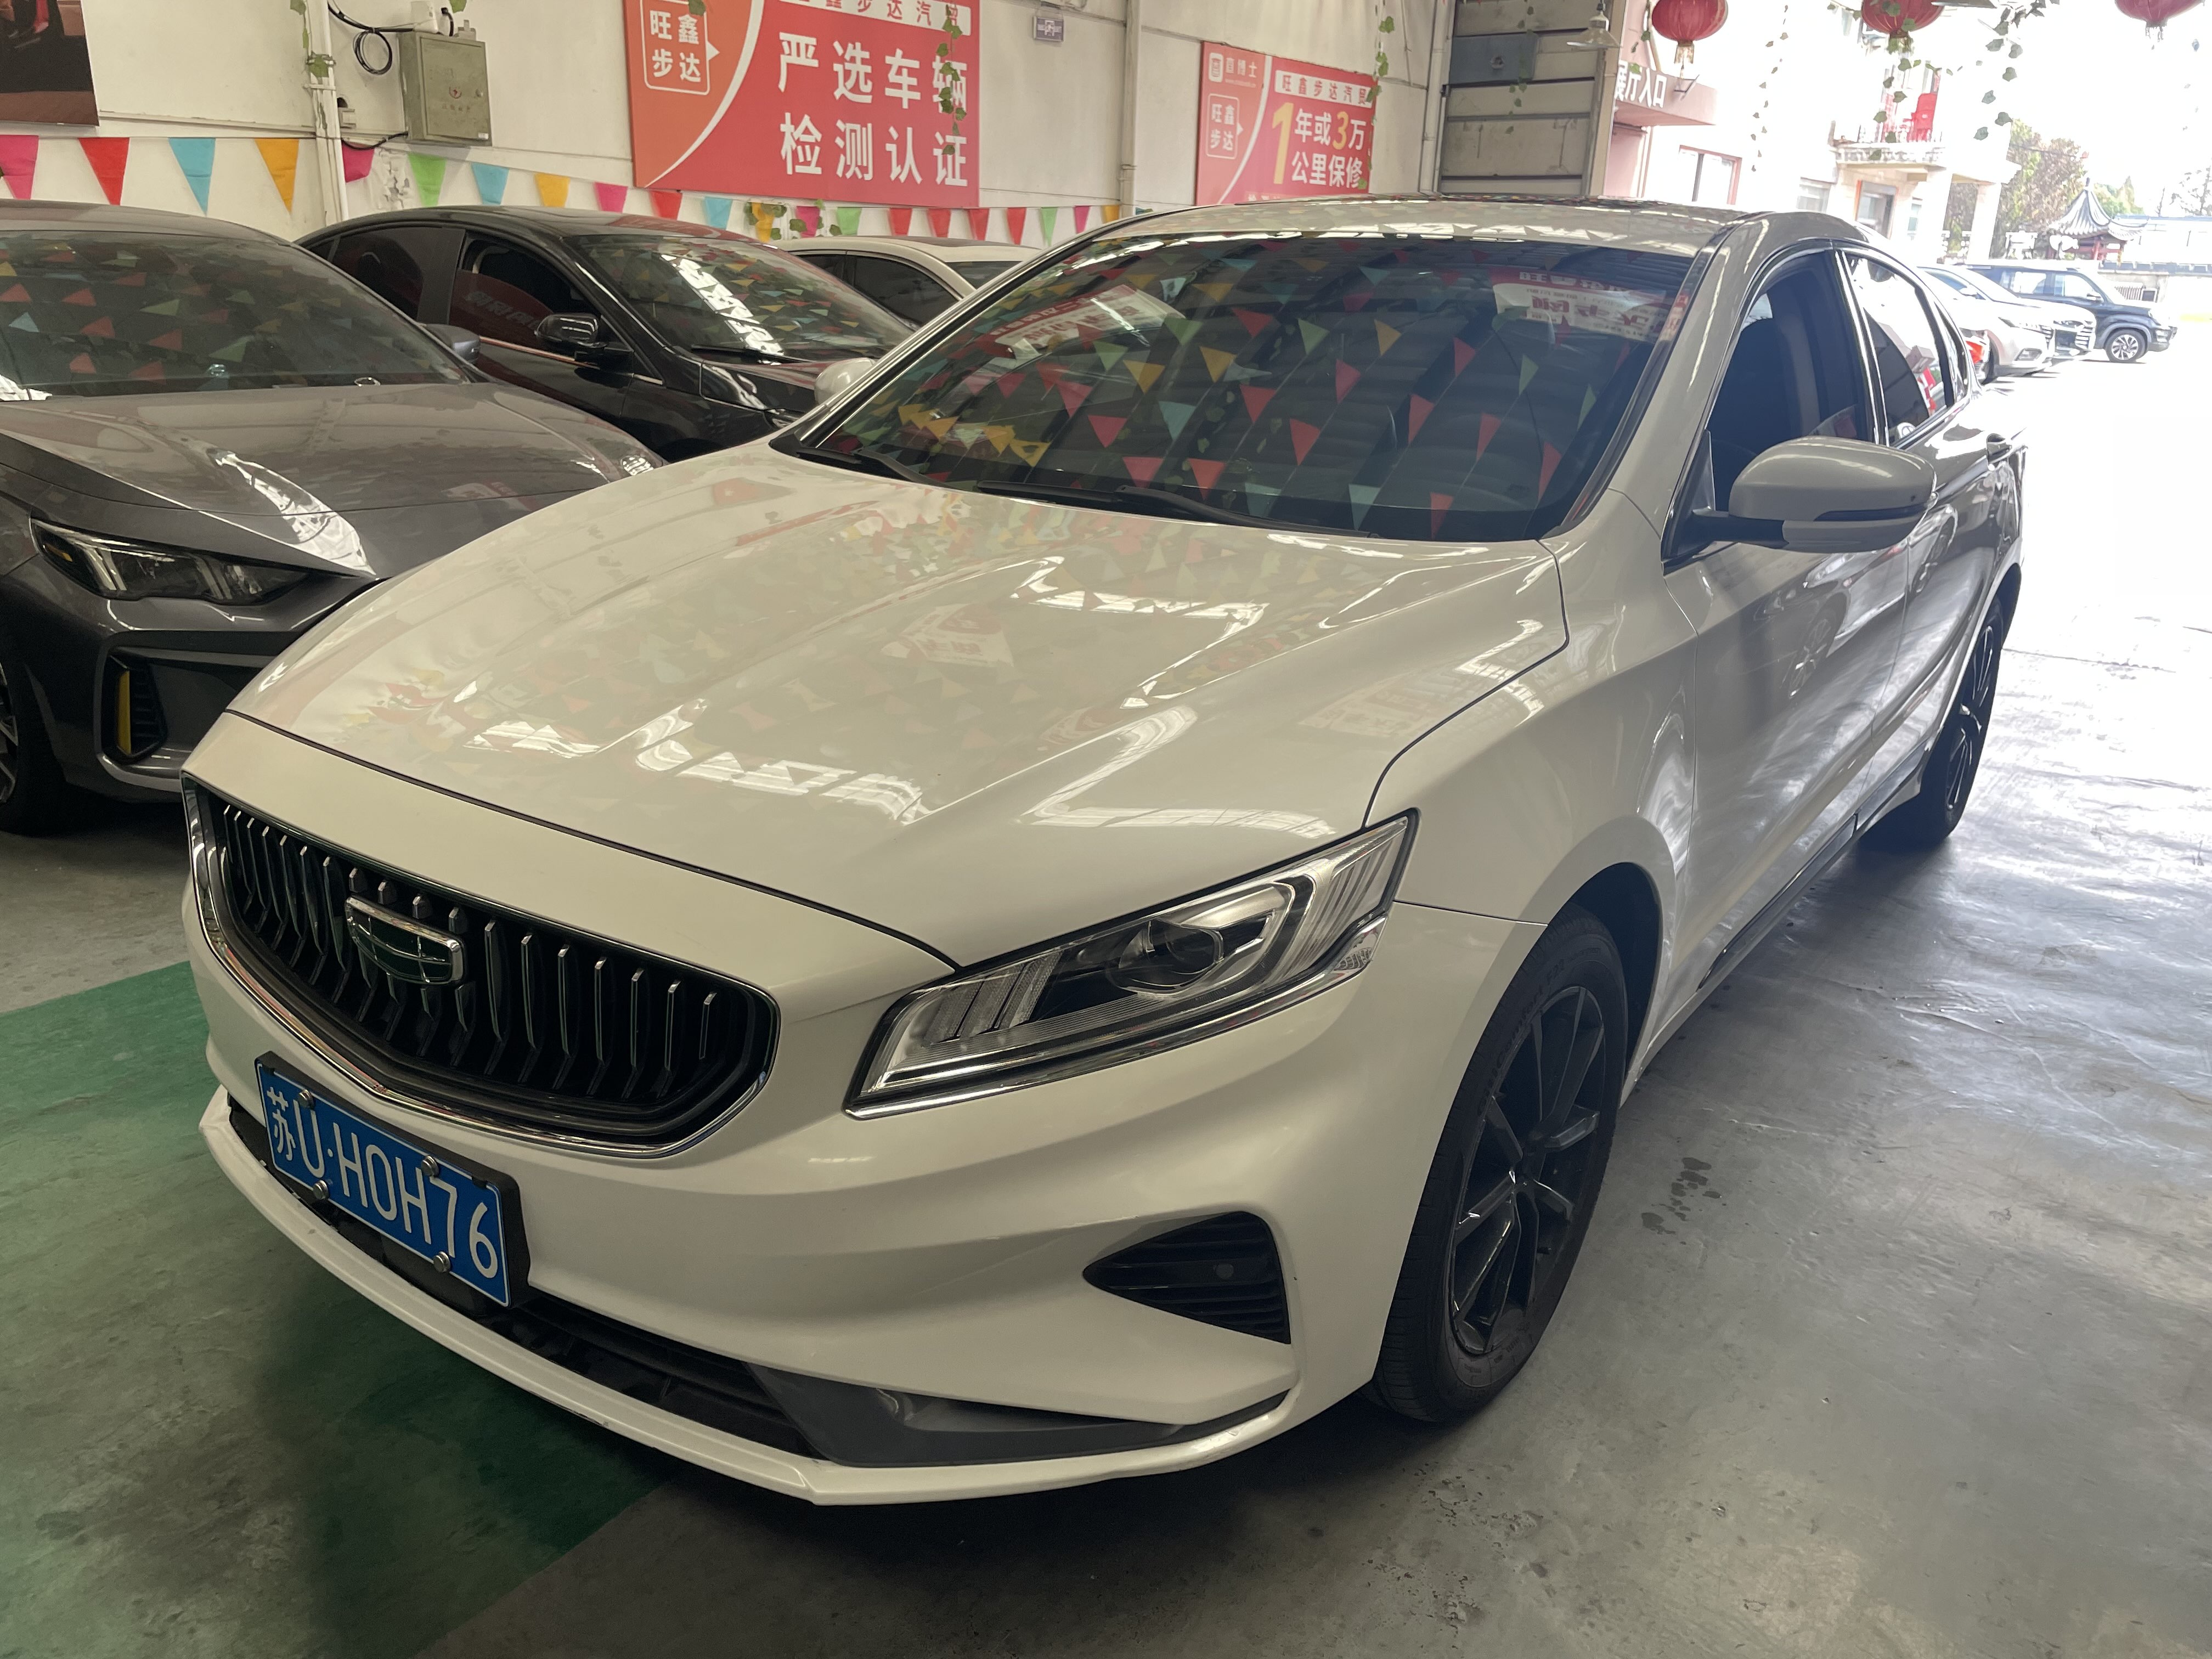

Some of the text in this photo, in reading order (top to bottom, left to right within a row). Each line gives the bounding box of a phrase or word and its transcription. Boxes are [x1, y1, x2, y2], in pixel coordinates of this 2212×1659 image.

[650, 10, 699, 44] 旺鑫
[788, 0, 958, 25] 步达汽
[652, 48, 701, 82] 步达
[778, 32, 968, 114] 严选车辆
[780, 112, 968, 187] 检测认证
[1291, 151, 1363, 189] 公里保修
